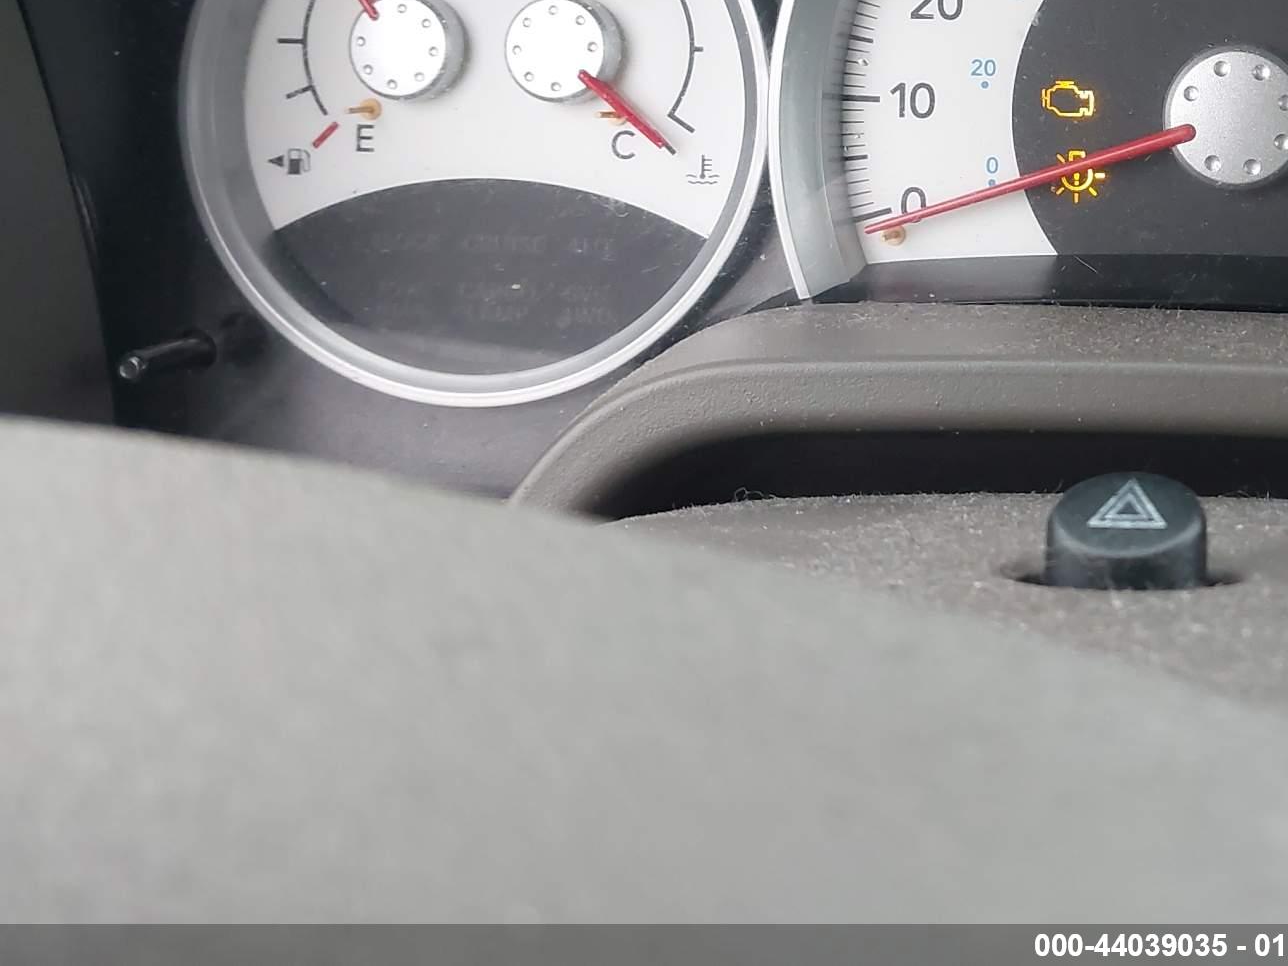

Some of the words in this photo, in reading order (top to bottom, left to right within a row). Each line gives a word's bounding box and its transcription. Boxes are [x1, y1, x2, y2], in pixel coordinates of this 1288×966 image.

[970, 58, 995, 77] 20
[890, 83, 935, 118] 10
[356, 124, 374, 152] E
[612, 130, 635, 159] C
[986, 157, 999, 175] 0
[901, 187, 927, 223] 0
